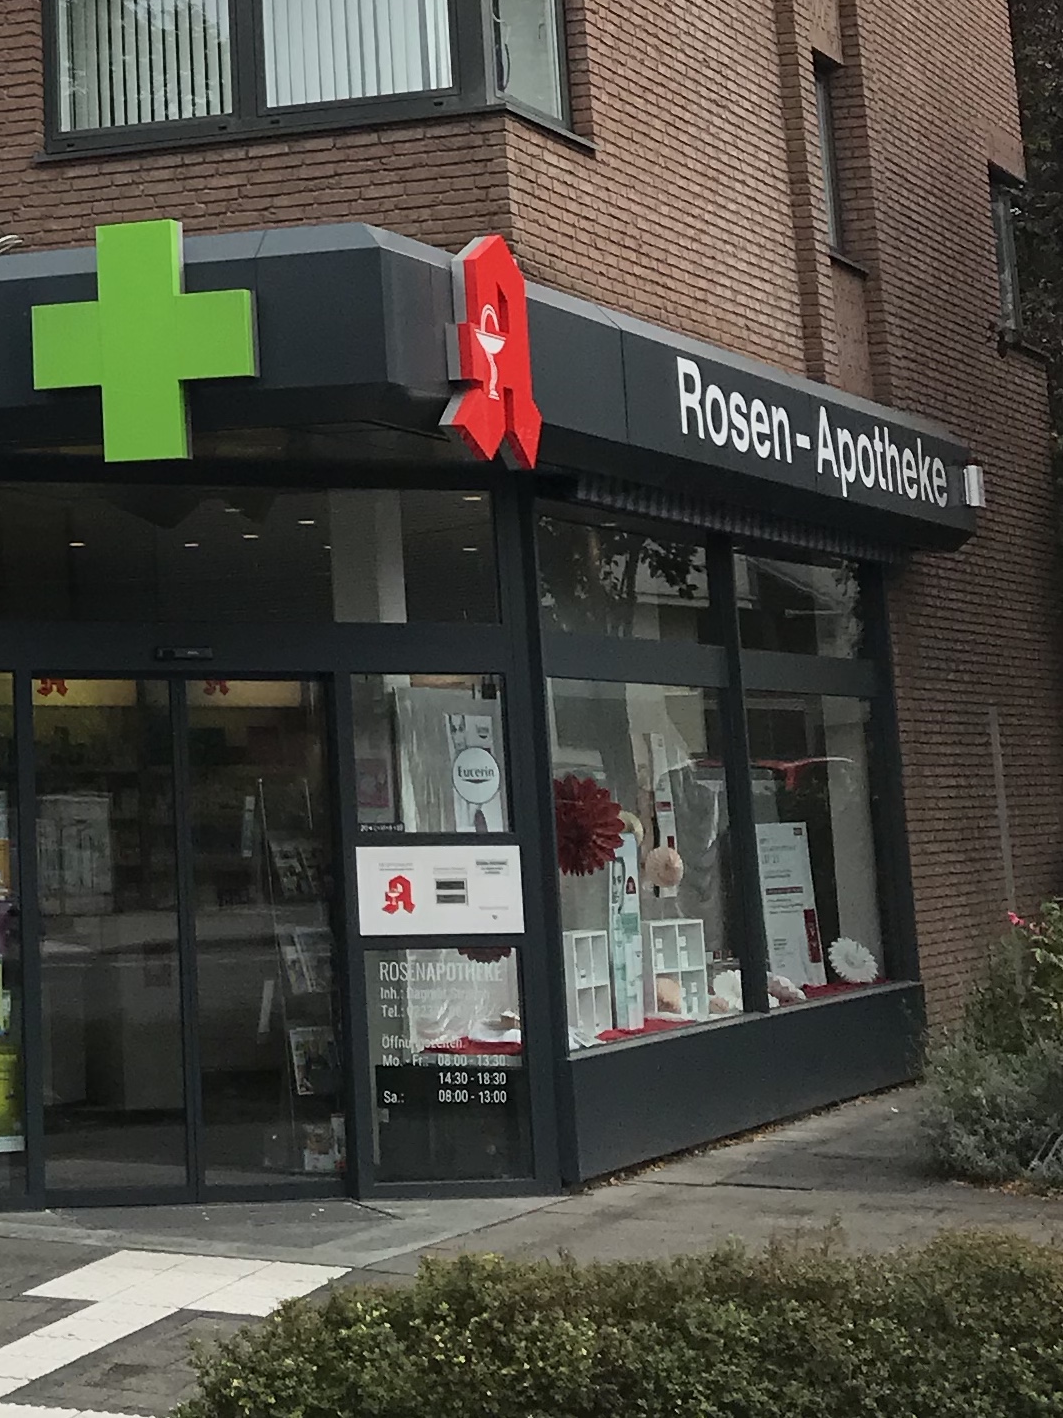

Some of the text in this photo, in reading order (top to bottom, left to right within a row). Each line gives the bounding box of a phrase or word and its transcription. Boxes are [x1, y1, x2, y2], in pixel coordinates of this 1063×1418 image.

[676, 356, 948, 508] Rosen-Apotheke
[457, 766, 495, 778] Eucerin
[379, 961, 503, 982] ROSENAPOTHEKE
[381, 1004, 404, 1018] Tel.:
[438, 1072, 468, 1085] 14:30
[477, 1072, 507, 1085] 18:30
[383, 1090, 404, 1104] Sa.:
[438, 1089, 469, 1103] 08:00
[478, 1090, 507, 1104] 13:00
